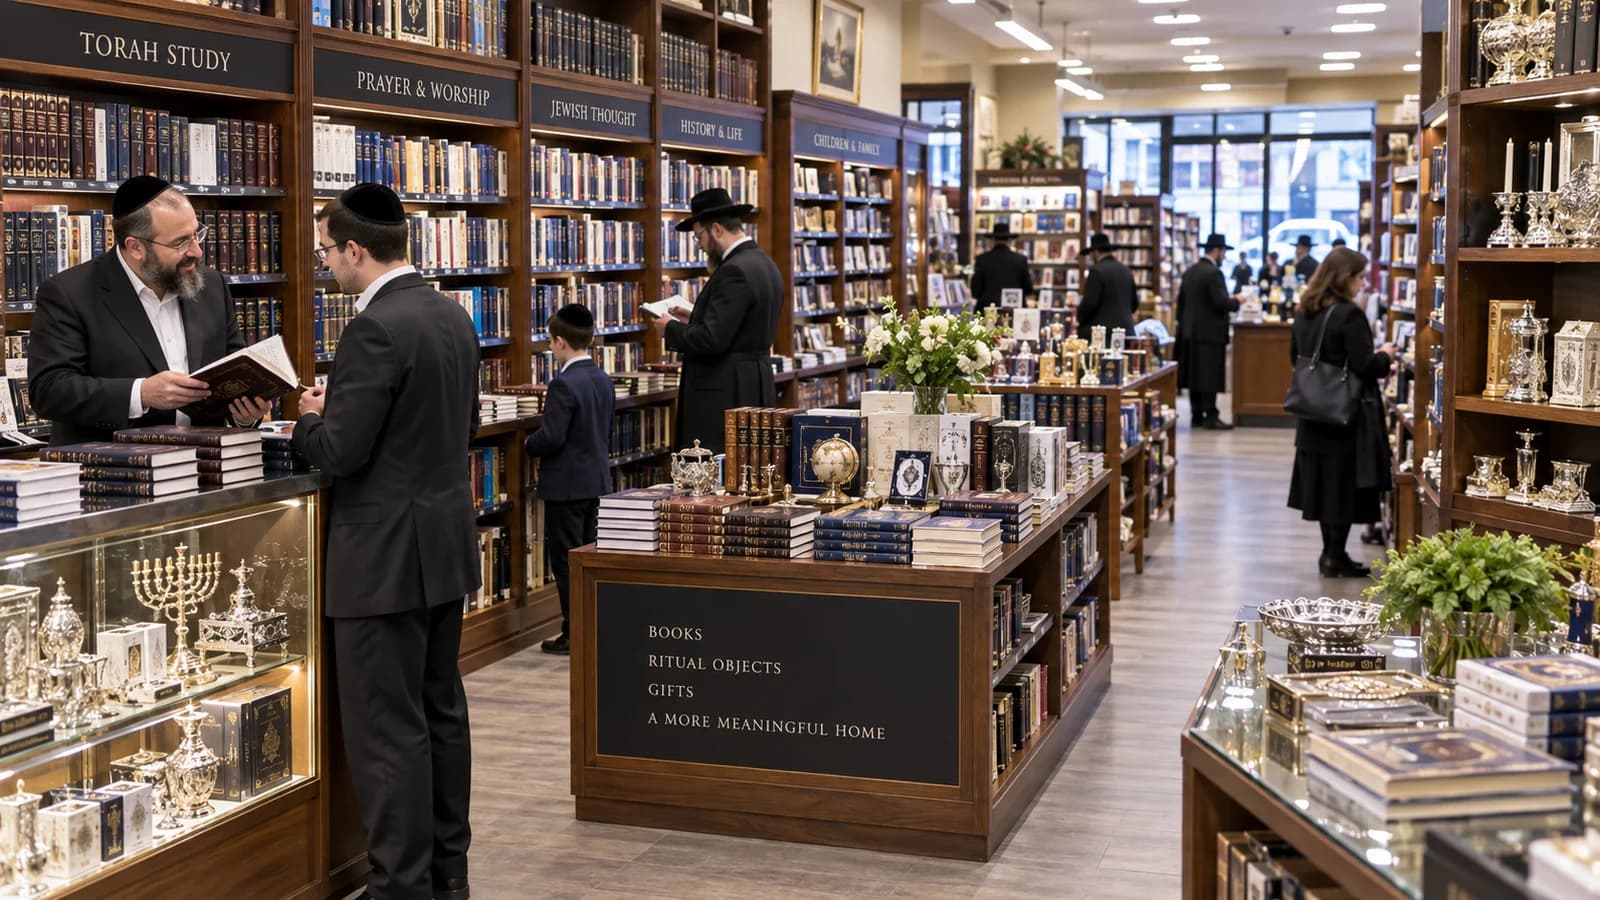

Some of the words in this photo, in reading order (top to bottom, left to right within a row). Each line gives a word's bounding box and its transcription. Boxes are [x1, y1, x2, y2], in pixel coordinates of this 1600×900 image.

[79, 31, 159, 63] TORAH
[167, 43, 231, 72] STUDY
[357, 70, 412, 96] PRAYER
[416, 80, 427, 98] &
[430, 81, 490, 107] WORSHIP
[550, 99, 588, 121] JEWISH
[590, 106, 637, 127] THOUGHT
[680, 119, 716, 137] HISTORY
[718, 124, 725, 139] &
[727, 126, 744, 141] LIFE
[814, 133, 849, 151] CHILDREN
[851, 140, 857, 152] &
[858, 140, 881, 156] FAMILY
[648, 625, 703, 641] BOOKS
[648, 654, 706, 670] RITUAL
[712, 658, 782, 676] OBJECTS
[648, 683, 694, 698] GIFTS
[647, 712, 658, 725] A
[664, 713, 711, 729] MORE
[717, 716, 828, 736] MEANINGFUL
[835, 724, 886, 740] HOME
